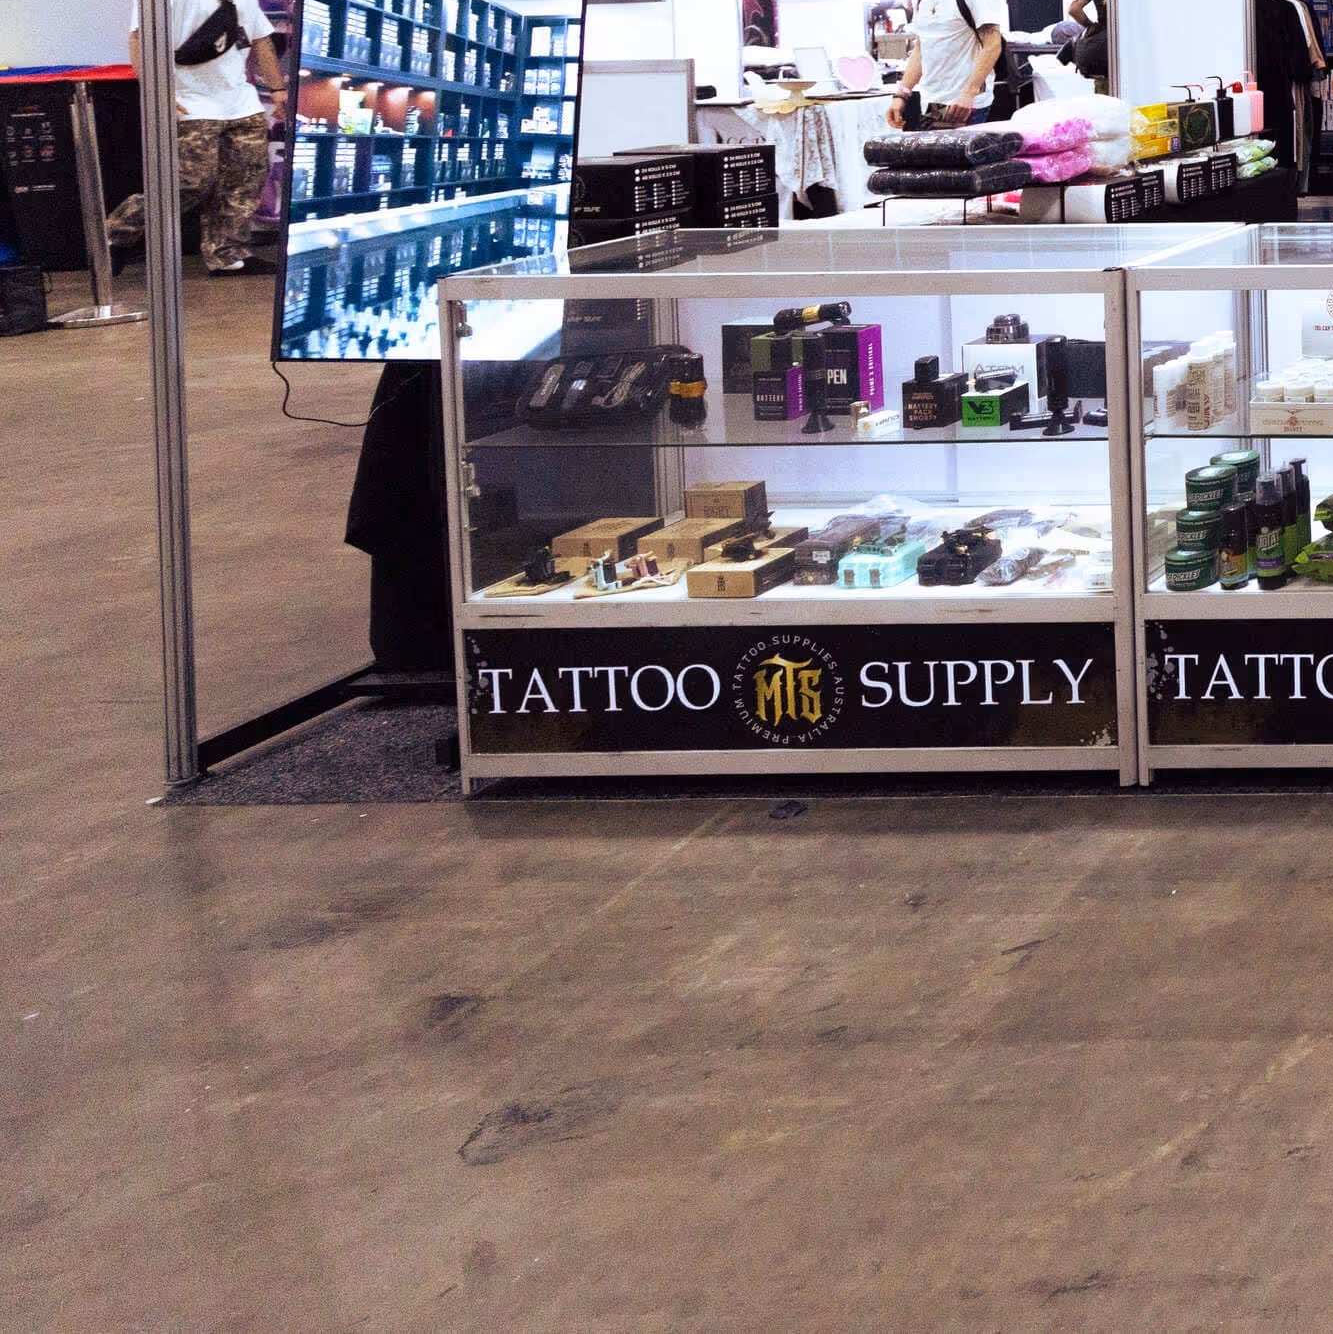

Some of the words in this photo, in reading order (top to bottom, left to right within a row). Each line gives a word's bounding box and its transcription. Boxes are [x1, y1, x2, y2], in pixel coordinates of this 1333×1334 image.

[827, 369, 847, 384] PEN
[479, 665, 720, 713] TATTOO
[860, 659, 1092, 707] SUPPLY
[732, 641, 766, 690] TATTOO
[772, 634, 837, 669] SUPPLIES
[753, 653, 822, 726] MTS
